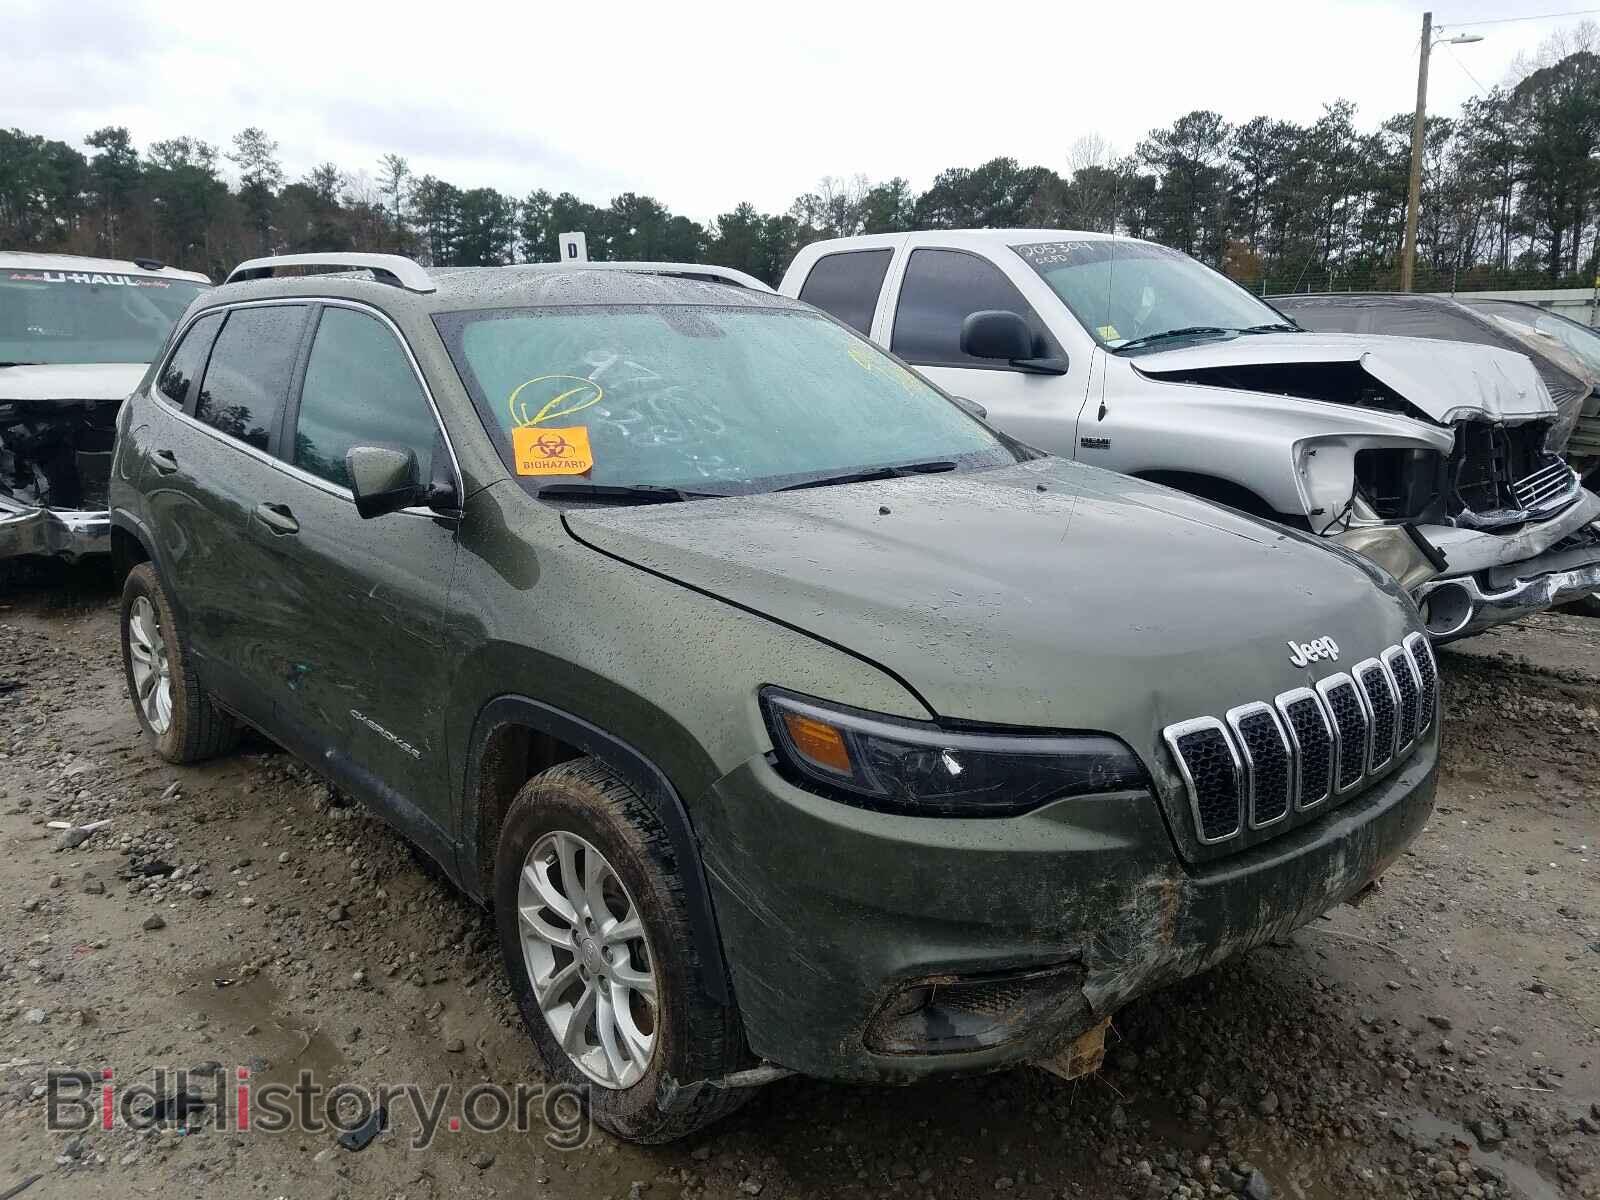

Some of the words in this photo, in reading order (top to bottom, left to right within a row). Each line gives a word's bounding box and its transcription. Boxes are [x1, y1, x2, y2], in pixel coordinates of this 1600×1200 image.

[568, 243, 578, 258] D
[43, 271, 138, 287] U-HAUL
[523, 460, 587, 470] BIOHAZARD
[1287, 635, 1339, 668] Jeep
